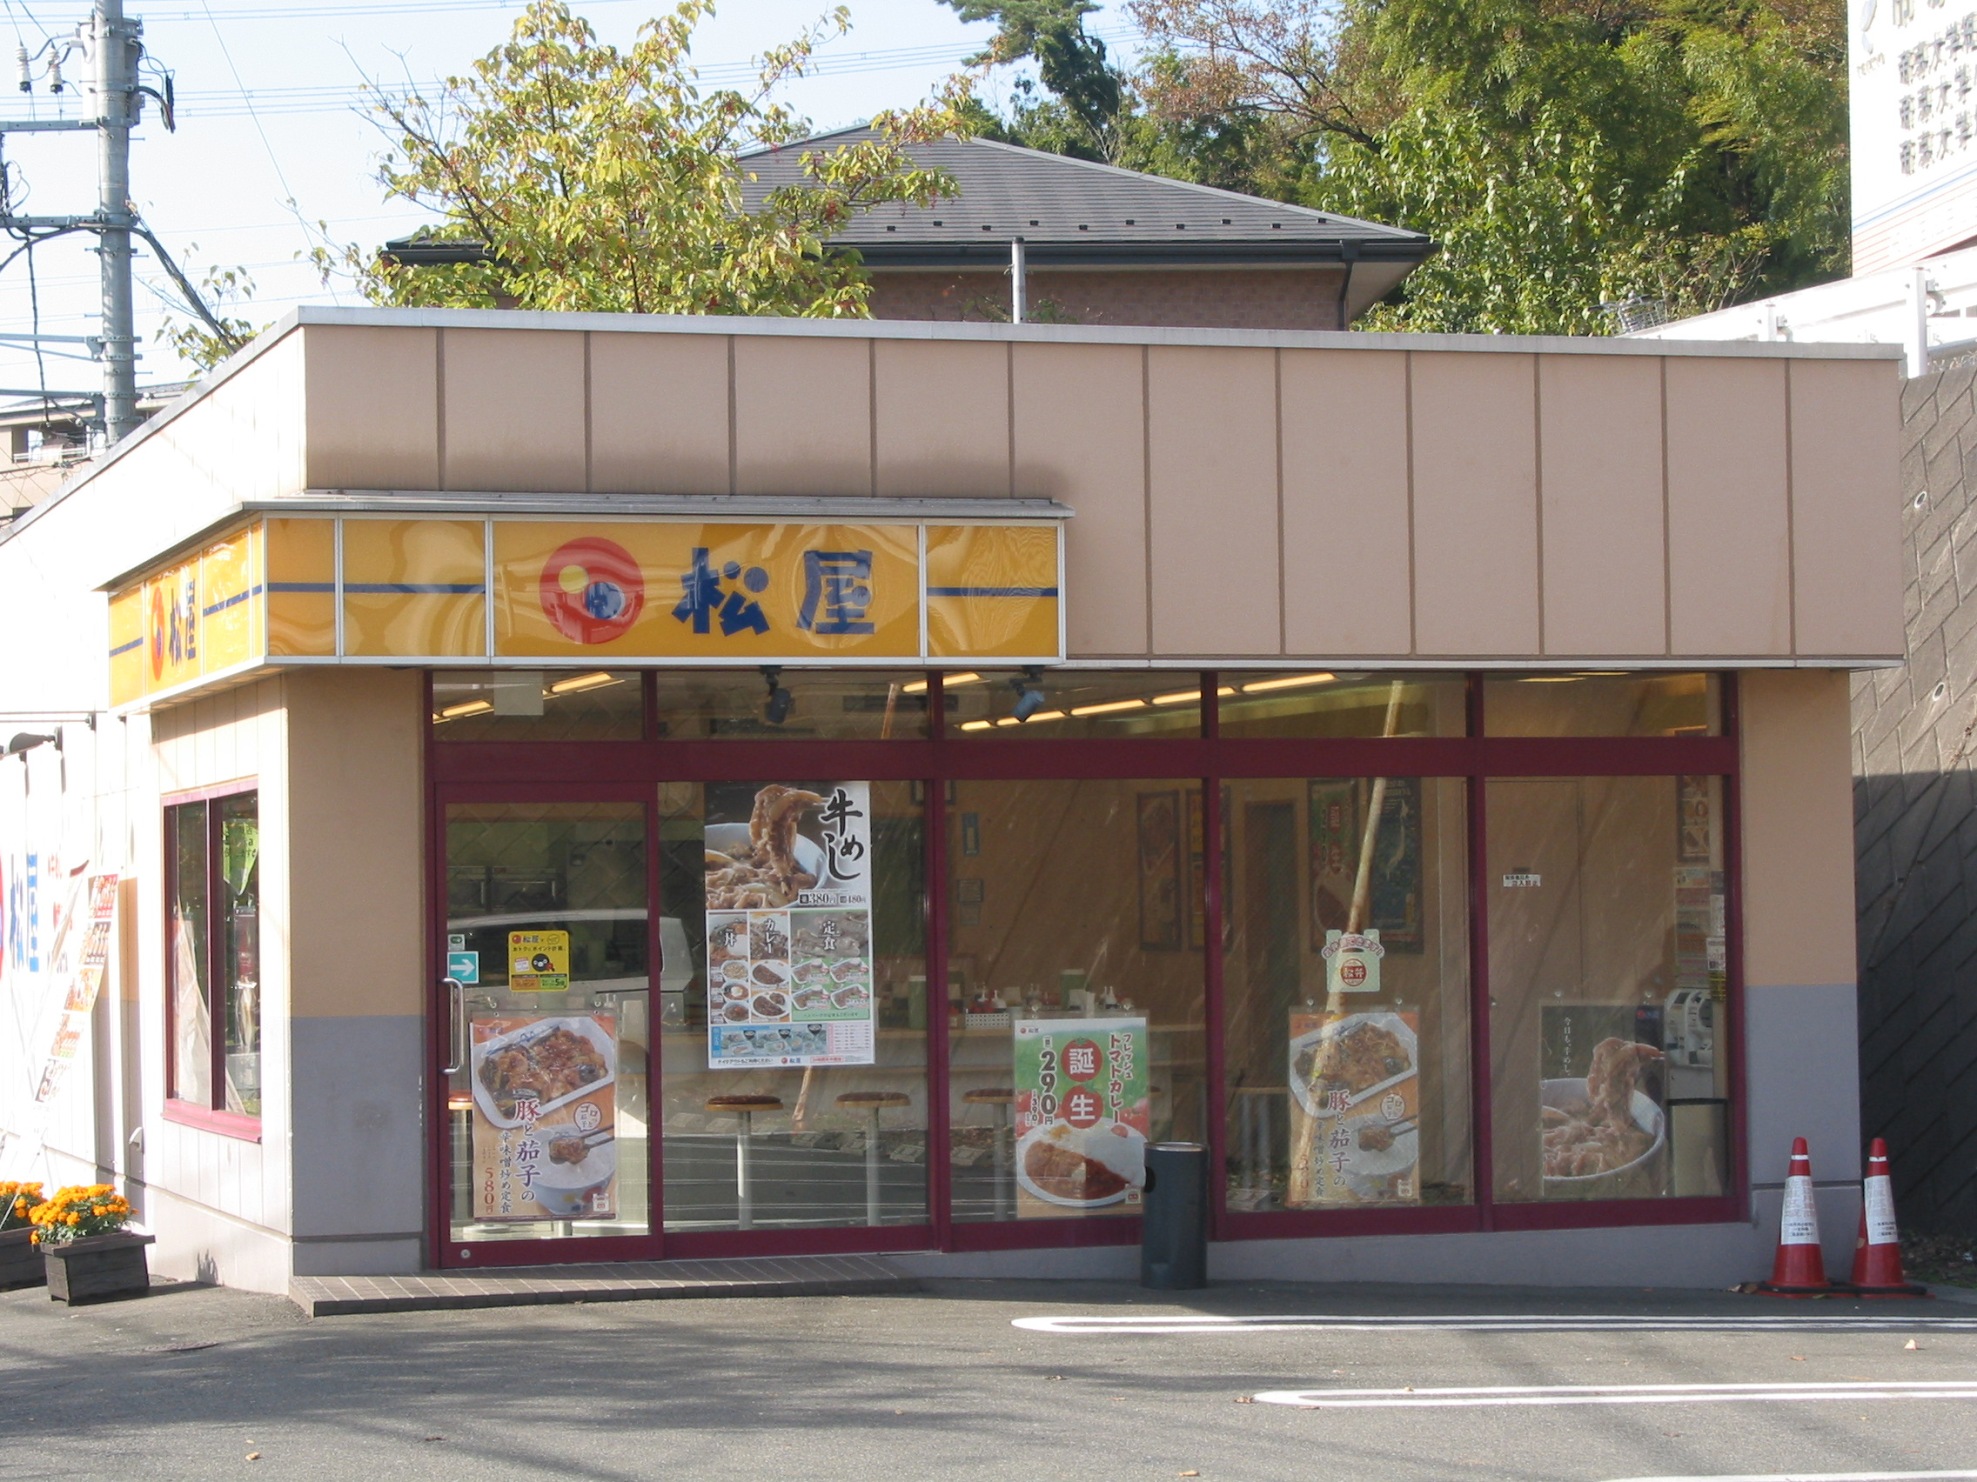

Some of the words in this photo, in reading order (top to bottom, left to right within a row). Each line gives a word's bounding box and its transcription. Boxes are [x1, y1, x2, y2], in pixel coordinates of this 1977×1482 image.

[671, 547, 875, 637] 松屋
[818, 786, 864, 882] 牛めし
[765, 918, 776, 954] カレー
[823, 920, 839, 950] 定食
[1040, 1050, 1058, 1126] 290円
[1068, 1046, 1096, 1122] 誕生
[1108, 1033, 1122, 1124] トマトカレー
[1123, 1033, 1133, 1080] フレッシュ
[515, 1100, 542, 1202] 豚と茄子の
[1328, 1090, 1351, 1186] 豚と茄子の
